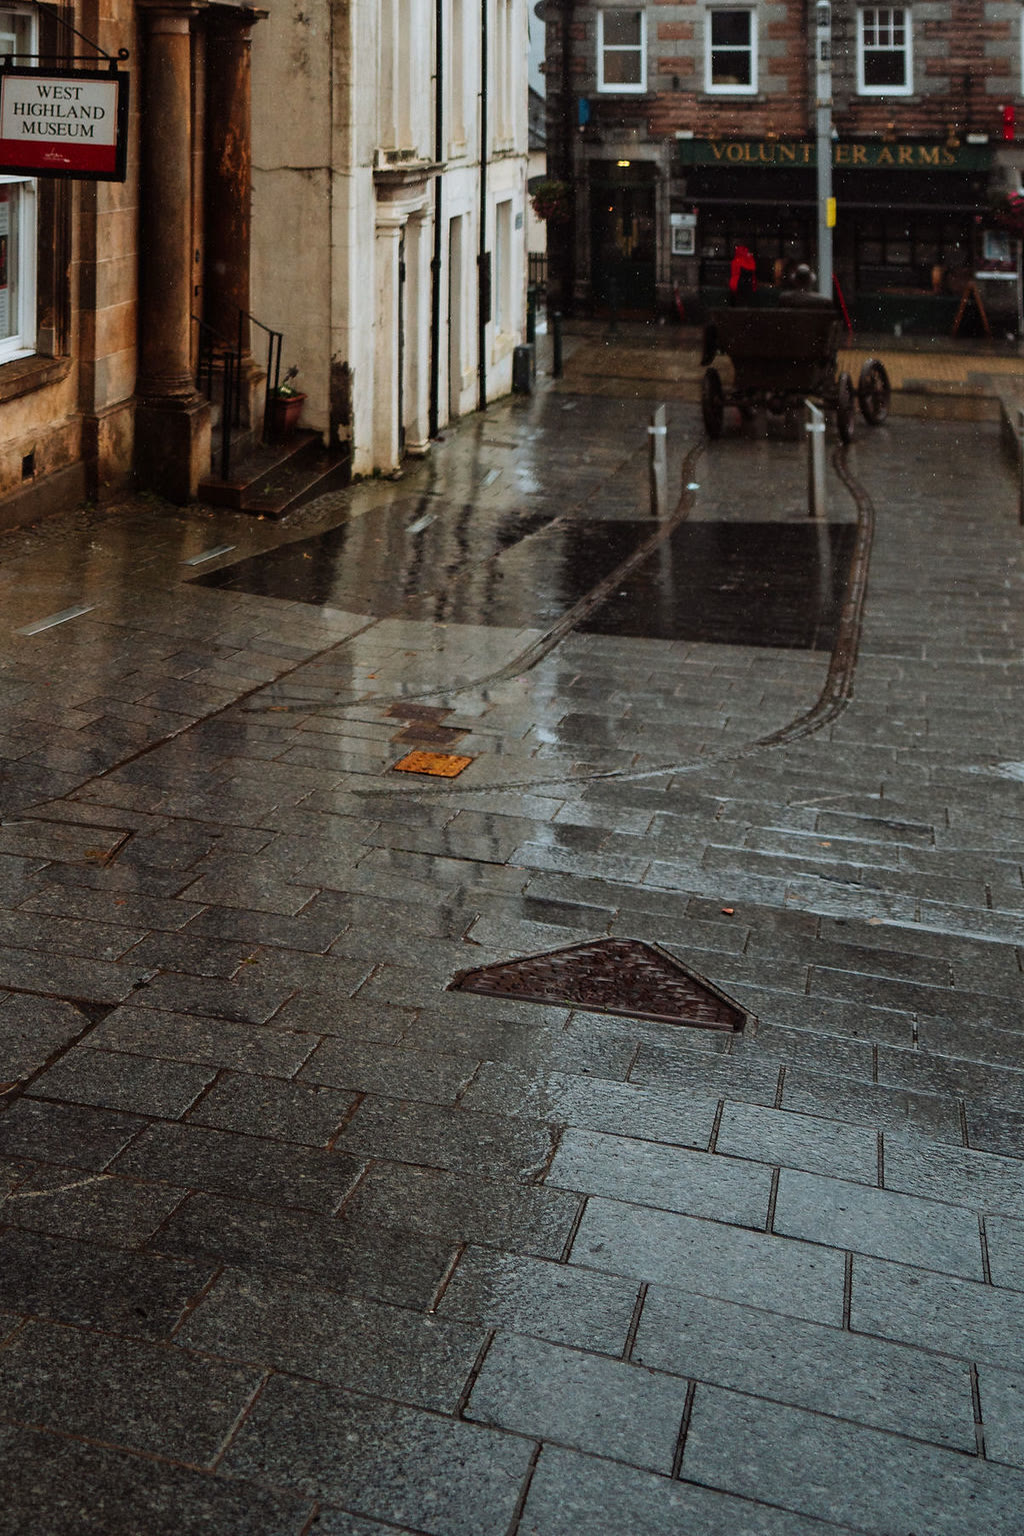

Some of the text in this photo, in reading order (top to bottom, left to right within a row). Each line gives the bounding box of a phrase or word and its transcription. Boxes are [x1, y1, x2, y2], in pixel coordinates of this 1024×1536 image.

[37, 85, 83, 101] WEST
[13, 102, 105, 120] HIGHLAND
[21, 120, 95, 138] MUSEUM
[710, 142, 958, 166] VOLUNTER ARMS
